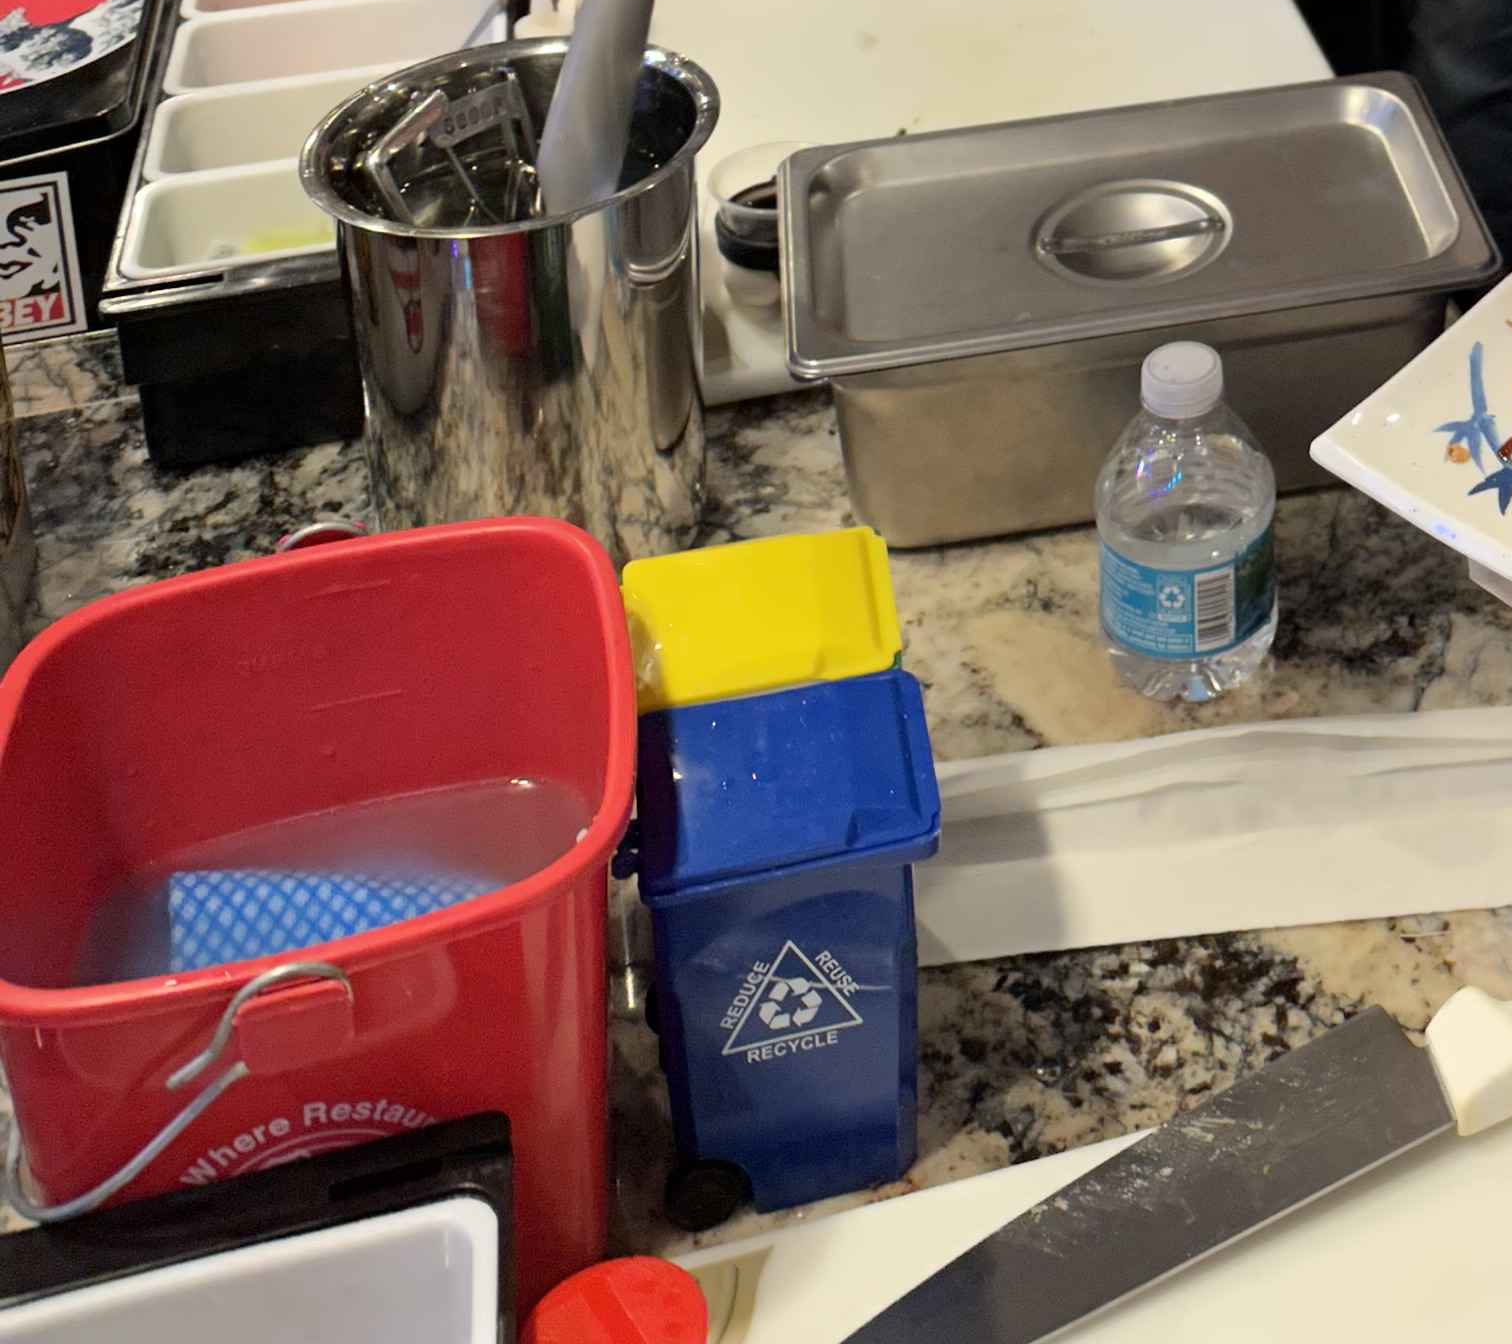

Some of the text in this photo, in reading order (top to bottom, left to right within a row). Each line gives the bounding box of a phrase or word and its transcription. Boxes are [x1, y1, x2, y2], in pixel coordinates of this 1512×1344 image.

[720, 960, 770, 1030] REDUCE
[815, 950, 860, 997] REUSE
[746, 1030, 839, 1063] RECYCLE
[179, 1117, 291, 1186] Where
